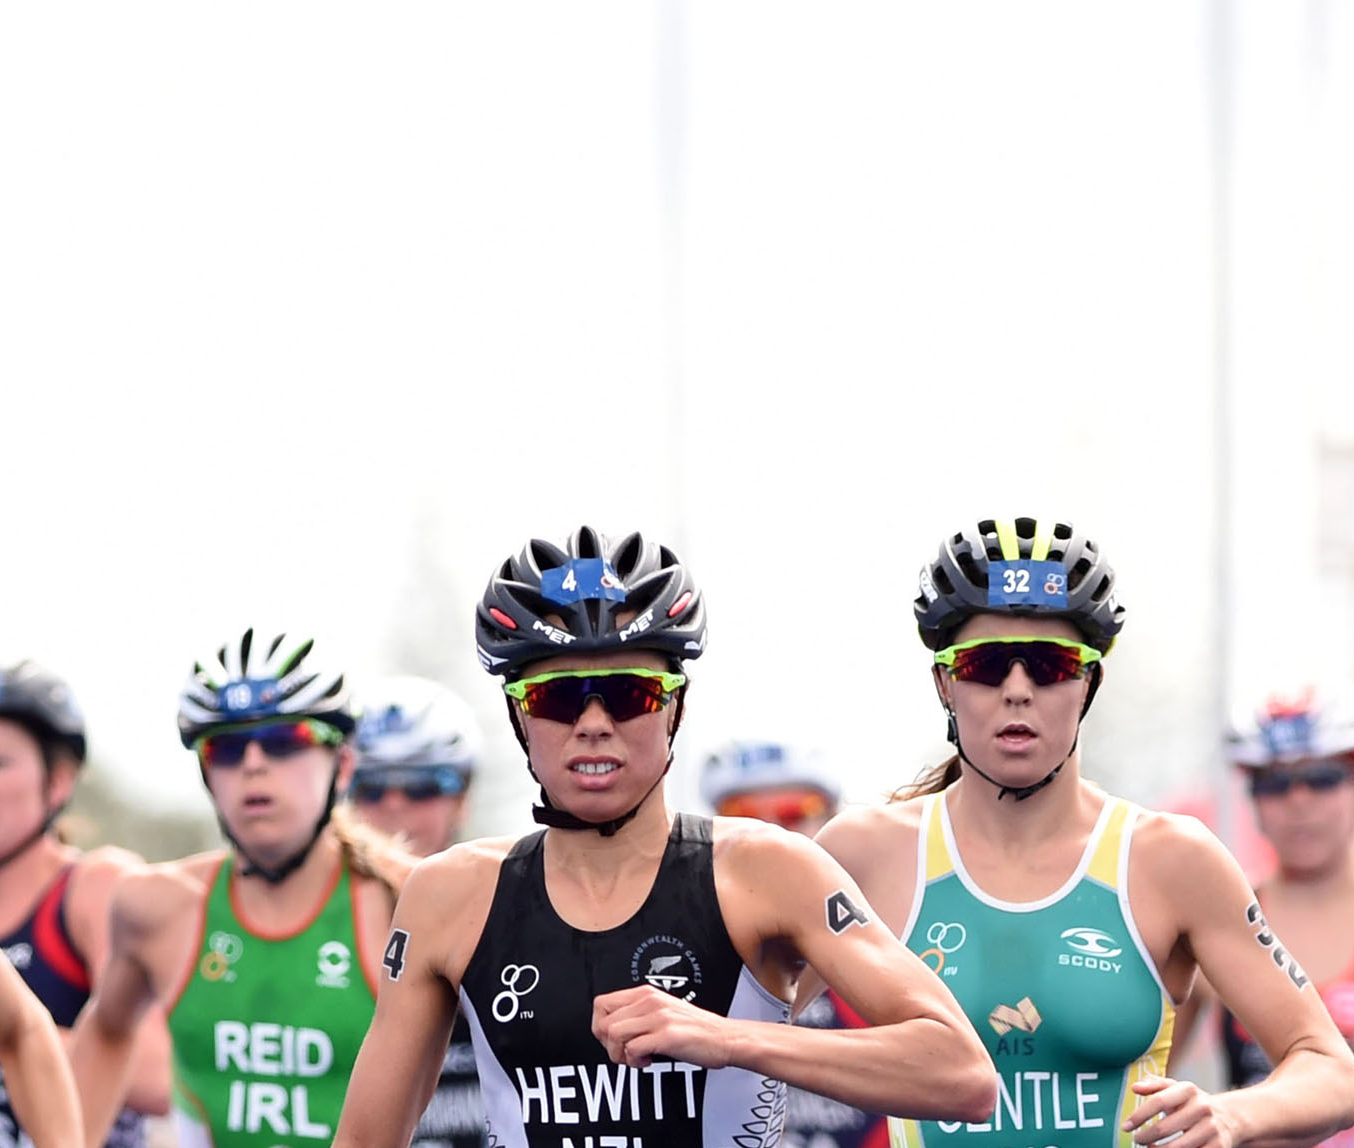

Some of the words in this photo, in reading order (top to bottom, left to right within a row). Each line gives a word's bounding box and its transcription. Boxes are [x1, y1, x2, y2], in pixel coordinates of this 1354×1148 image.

[561, 569, 578, 592] 4
[1003, 569, 1030, 593] 32
[533, 619, 577, 645] MET
[619, 608, 654, 642] MET
[823, 890, 870, 936] 4
[382, 928, 411, 983] 4
[1058, 954, 1122, 974] SCODY
[214, 1020, 335, 1078] REID
[997, 1037, 1035, 1056] AIS
[226, 1080, 332, 1139] IRL
[515, 1061, 703, 1124] HEWITT
[937, 1071, 1105, 1134] NTLE
